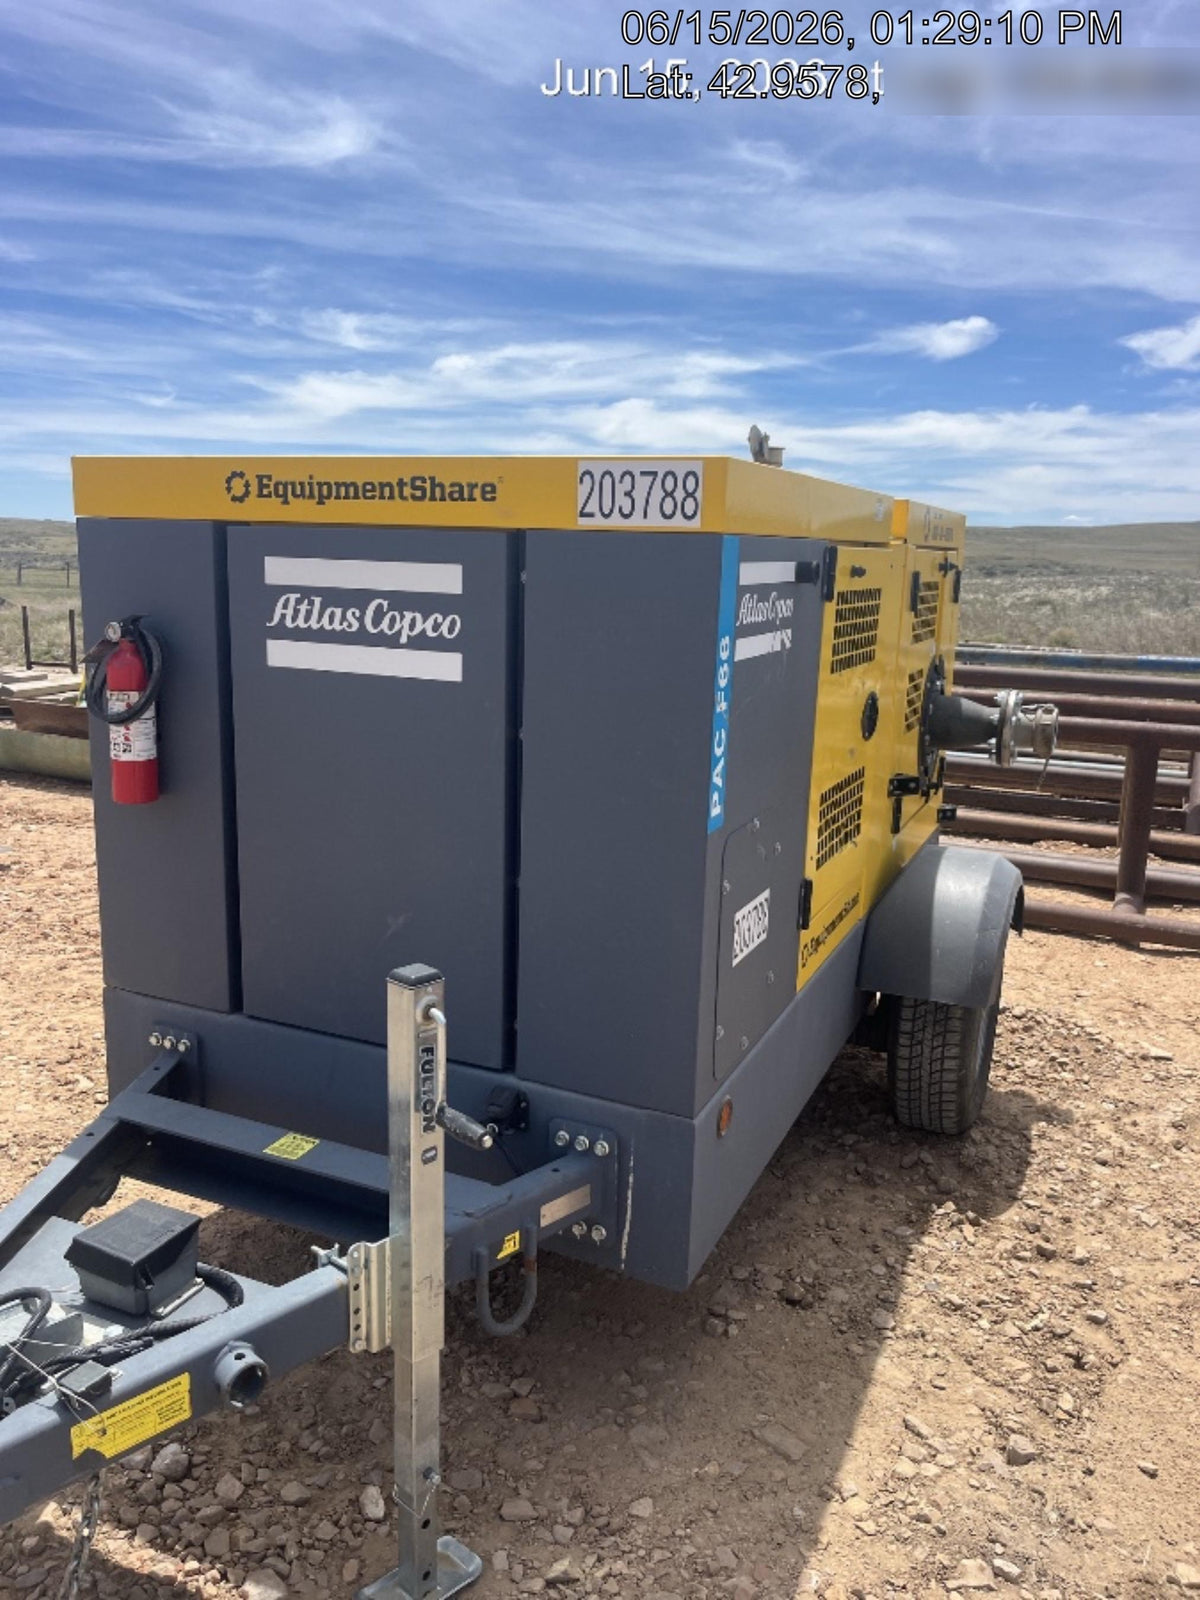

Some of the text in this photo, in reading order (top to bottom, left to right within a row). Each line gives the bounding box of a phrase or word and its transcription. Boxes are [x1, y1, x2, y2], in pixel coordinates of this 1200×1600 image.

[255, 473, 498, 506] EquipmentShare
[578, 468, 700, 521] 203788
[266, 592, 462, 645] Atlas Copco
[735, 592, 769, 627] Atlas
[710, 727, 728, 818] PAC
